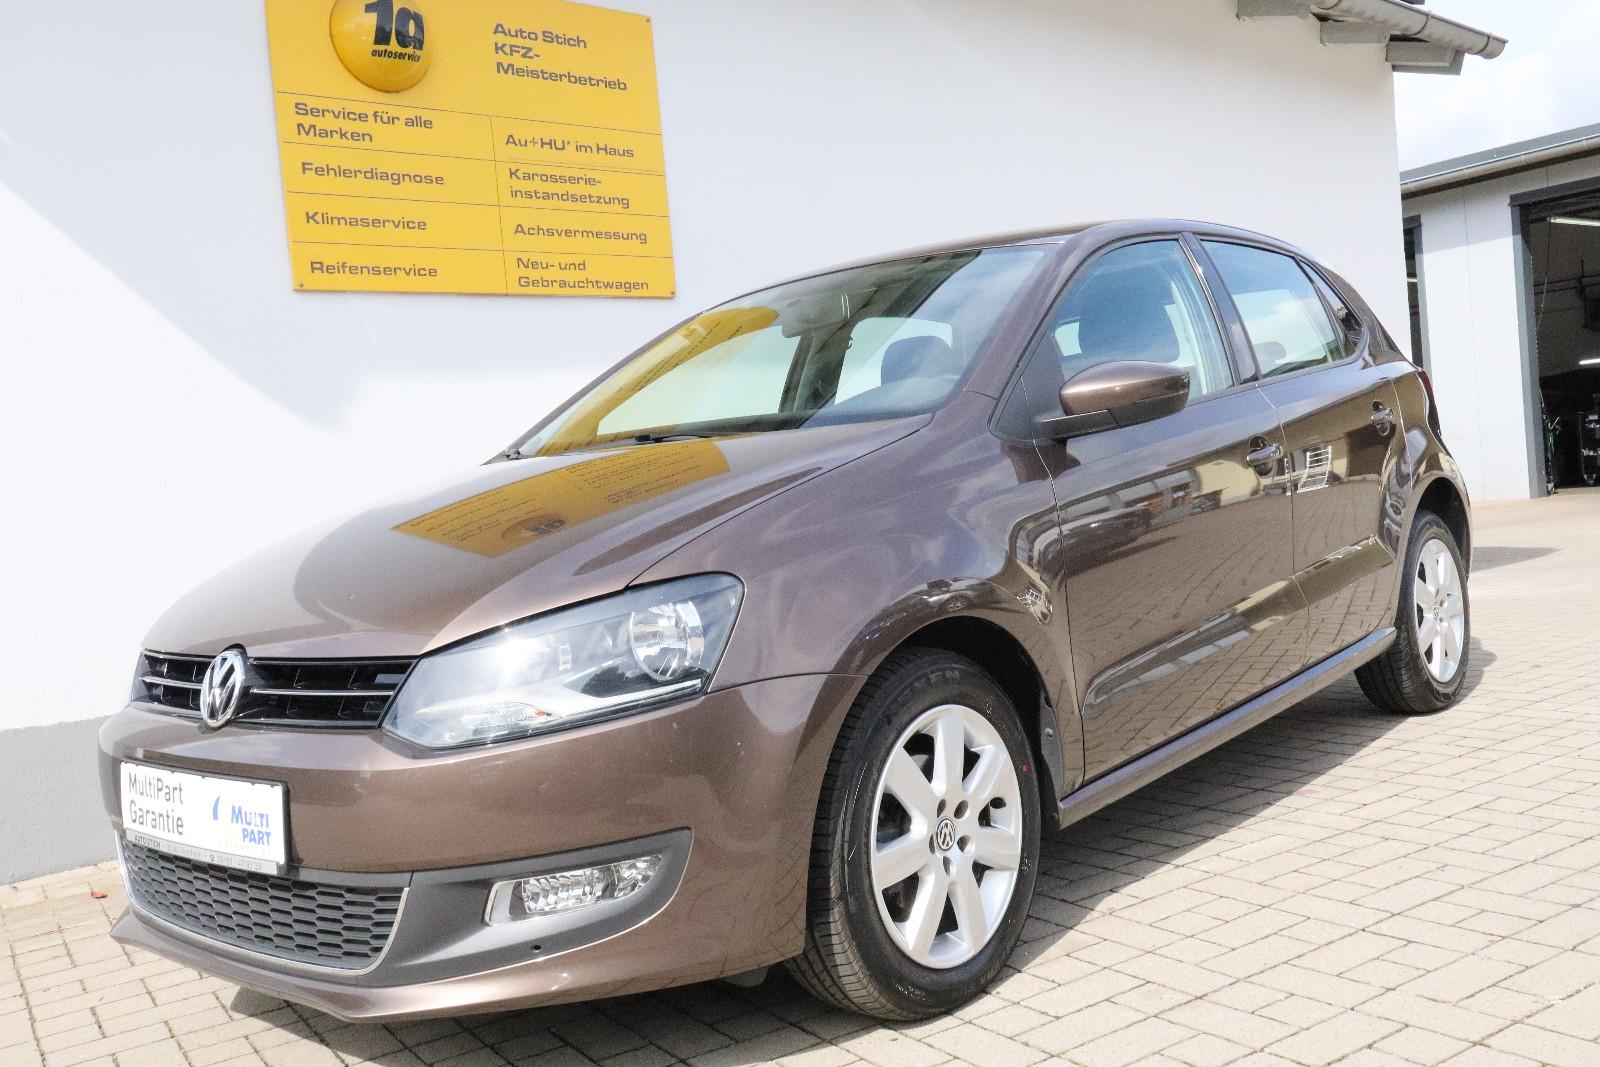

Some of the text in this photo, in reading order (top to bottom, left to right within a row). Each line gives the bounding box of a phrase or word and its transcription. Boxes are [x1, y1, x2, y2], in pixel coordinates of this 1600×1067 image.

[492, 23, 587, 49] Auto Stich
[371, 48, 421, 62] autoservice
[494, 42, 541, 61] KFZ-
[496, 62, 627, 91] Meisterbetrieb
[294, 102, 433, 129] Service für alle
[296, 123, 373, 143] Marken
[575, 141, 593, 154] im
[596, 143, 634, 158] Haus
[301, 162, 444, 186] Fehlerdiagnose
[509, 168, 602, 187] Karosserie-
[510, 187, 630, 209] instandsetzung
[305, 211, 427, 231] Klimaservice
[514, 224, 648, 244] Achsvermessung
[310, 261, 438, 278] Reifenservice
[517, 258, 586, 271] Neu- und
[518, 277, 649, 292] Gebrauchtwagen
[128, 772, 184, 805] MultiPart
[129, 800, 184, 836] Garantie
[231, 805, 269, 829] MULTI
[242, 828, 271, 846] PART
